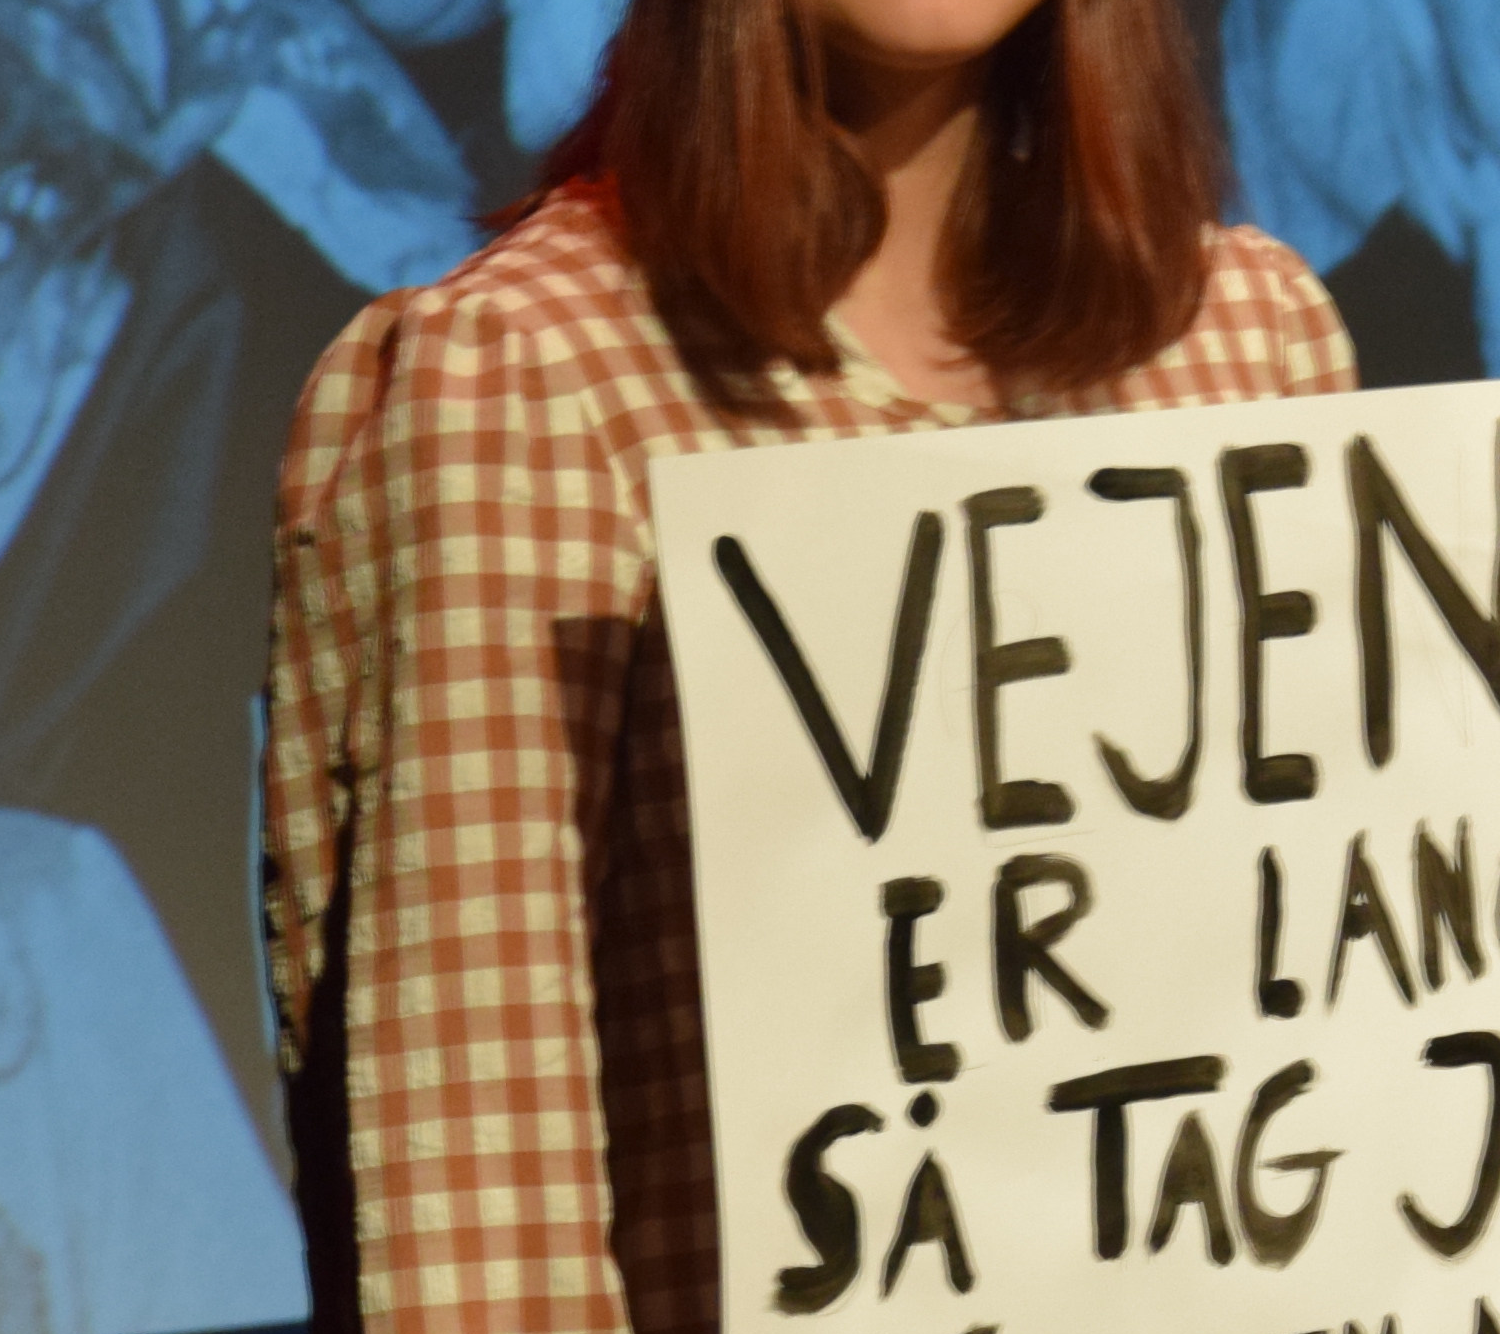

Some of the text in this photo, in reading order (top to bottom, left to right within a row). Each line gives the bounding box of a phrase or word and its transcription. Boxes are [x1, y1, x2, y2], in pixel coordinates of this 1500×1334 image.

[880, 852, 1110, 1086] ER
[771, 1091, 976, 1317] SÅ
[1046, 1054, 1346, 1267] TAG
